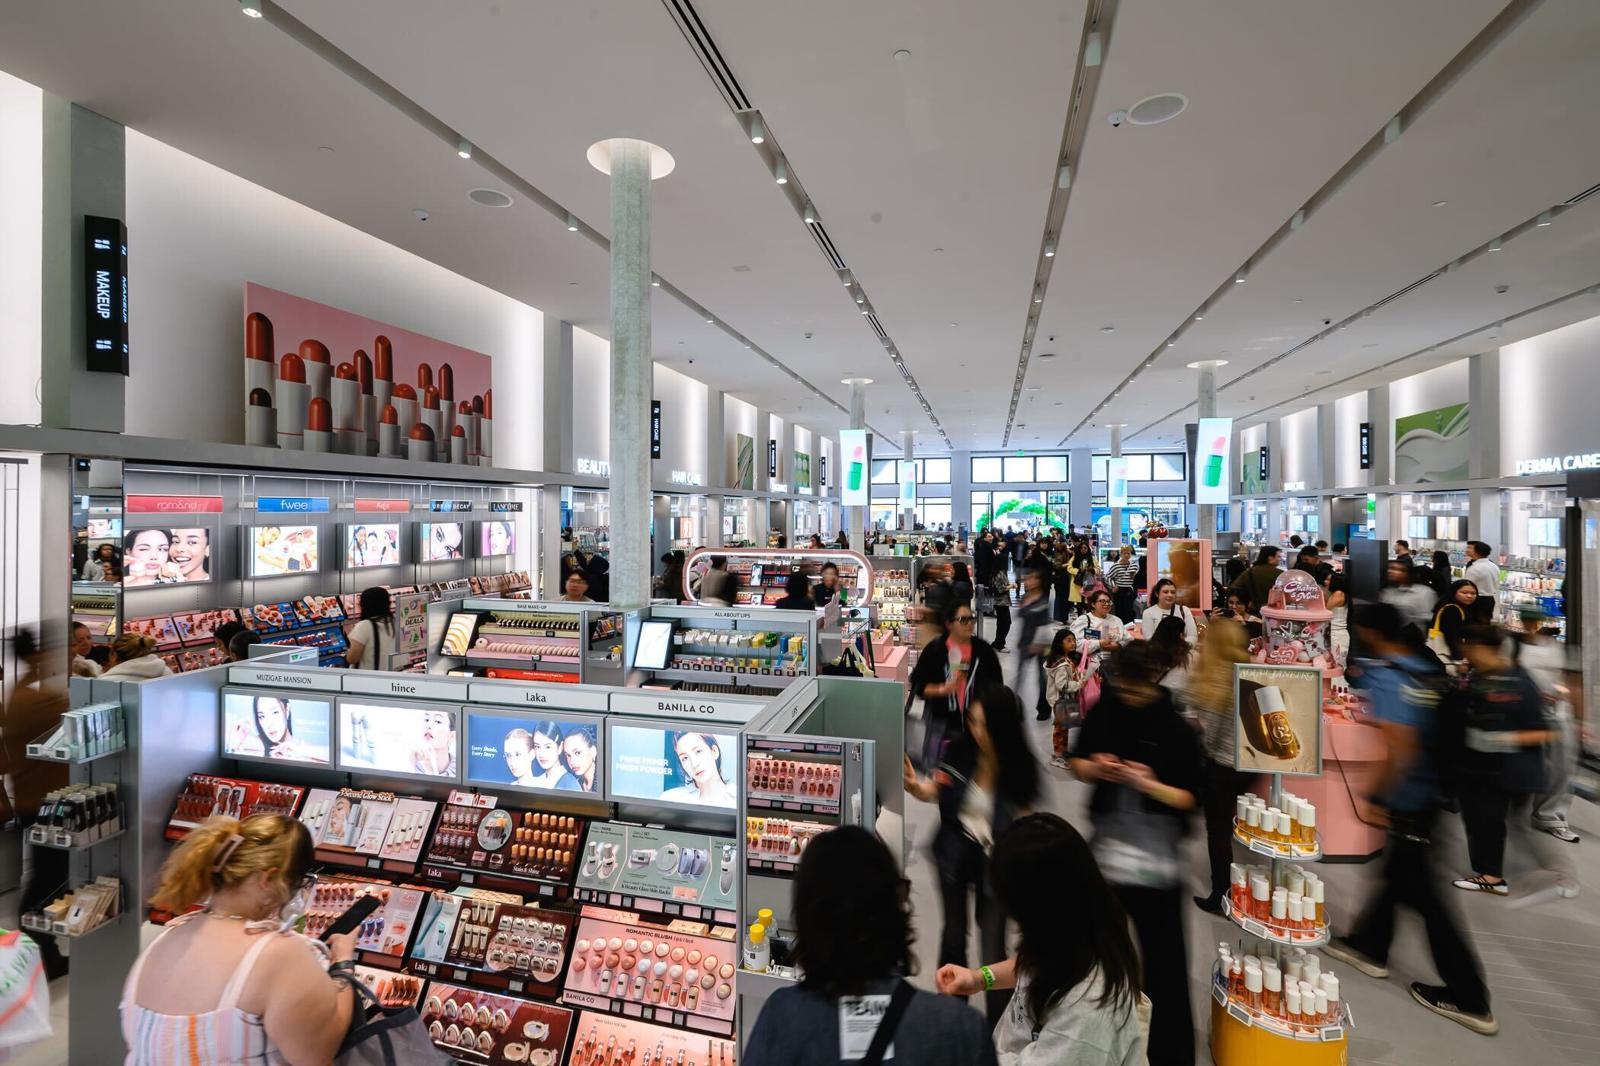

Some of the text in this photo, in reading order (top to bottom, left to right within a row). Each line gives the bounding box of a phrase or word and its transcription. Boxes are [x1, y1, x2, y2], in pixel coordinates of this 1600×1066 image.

[96, 270, 110, 319] MAKEUP
[1515, 453, 1600, 474] DERMA CARE
[280, 499, 308, 510] fwee
[405, 617, 424, 626] DEALS
[256, 674, 312, 684] MUZIGAE MANSION
[391, 682, 416, 693] hince
[526, 692, 546, 702] Laka
[658, 702, 714, 714] BANILA CO
[428, 868, 442, 877] Laka
[626, 928, 653, 937] ROMANTIC
[654, 932, 672, 940] BLUSH
